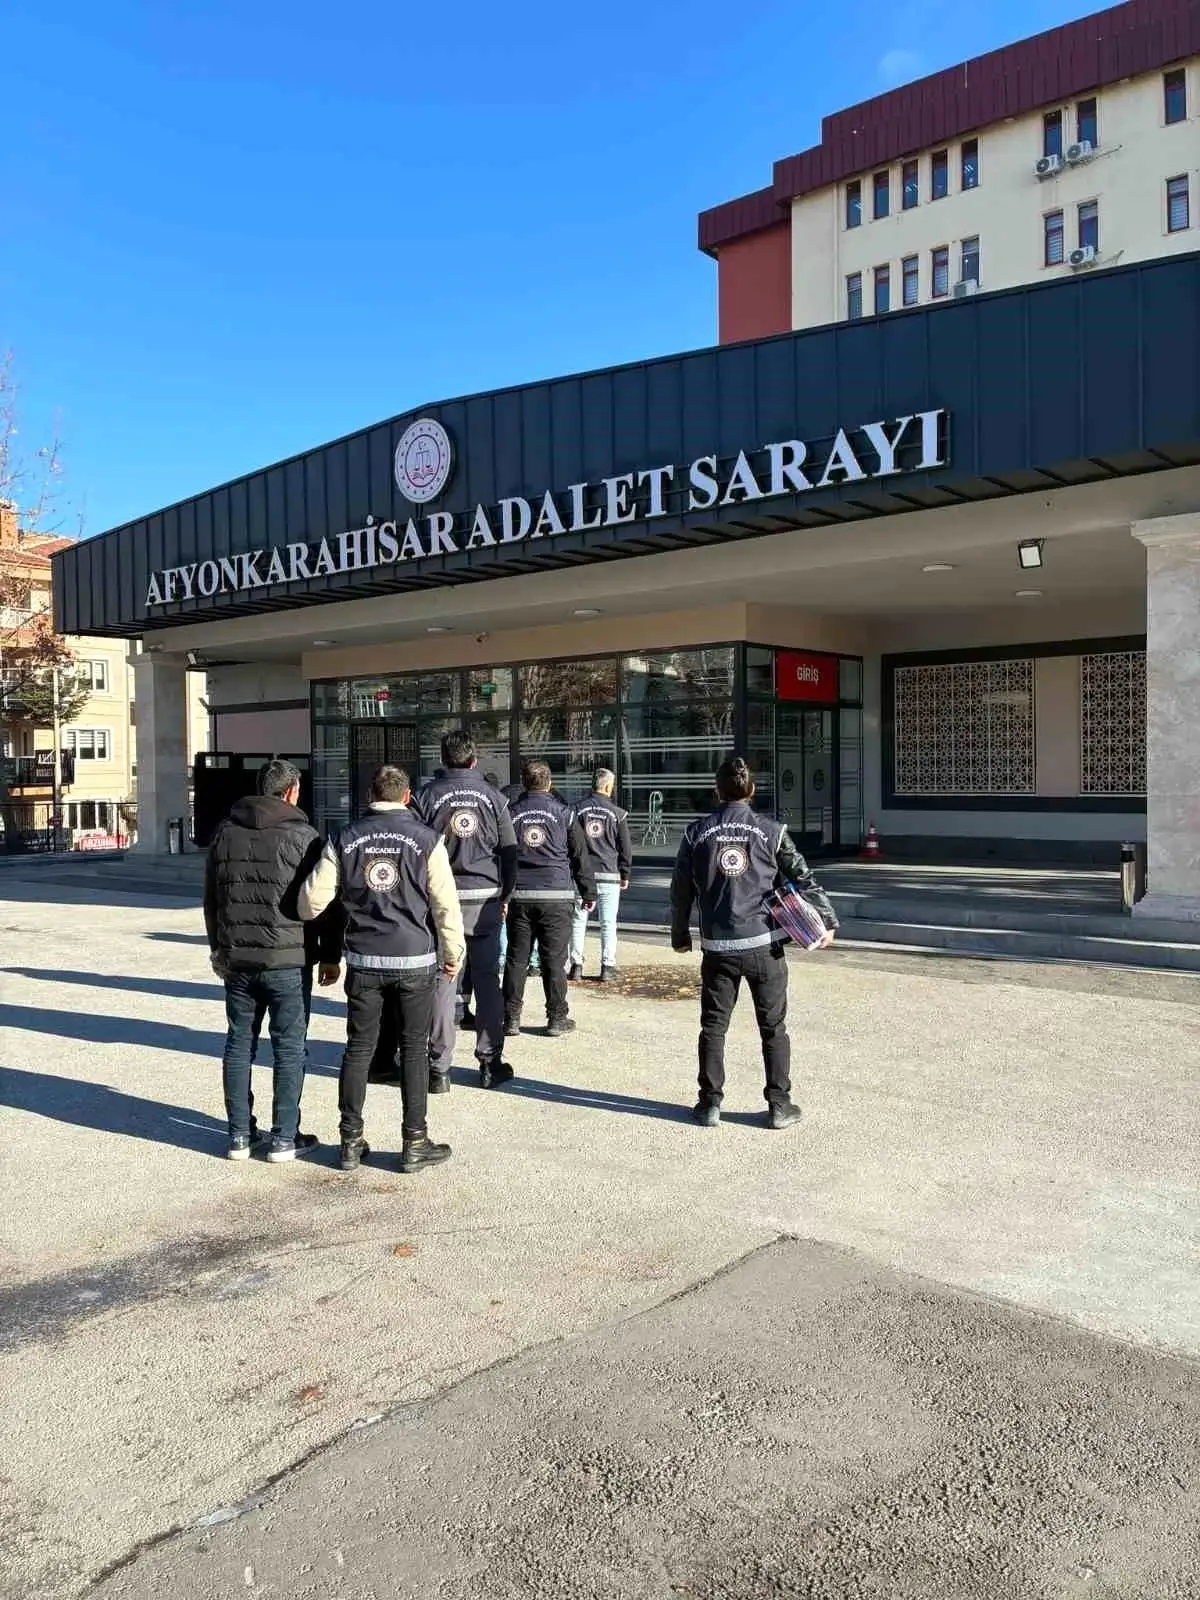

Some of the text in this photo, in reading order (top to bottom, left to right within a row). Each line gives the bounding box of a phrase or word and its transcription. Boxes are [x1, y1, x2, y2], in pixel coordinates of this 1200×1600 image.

[145, 408, 945, 606] AFYONKARAHİSAR ADALET SARAYI
[796, 664, 819, 686] GİRİŞ
[365, 846, 401, 854] MÜCADELE
